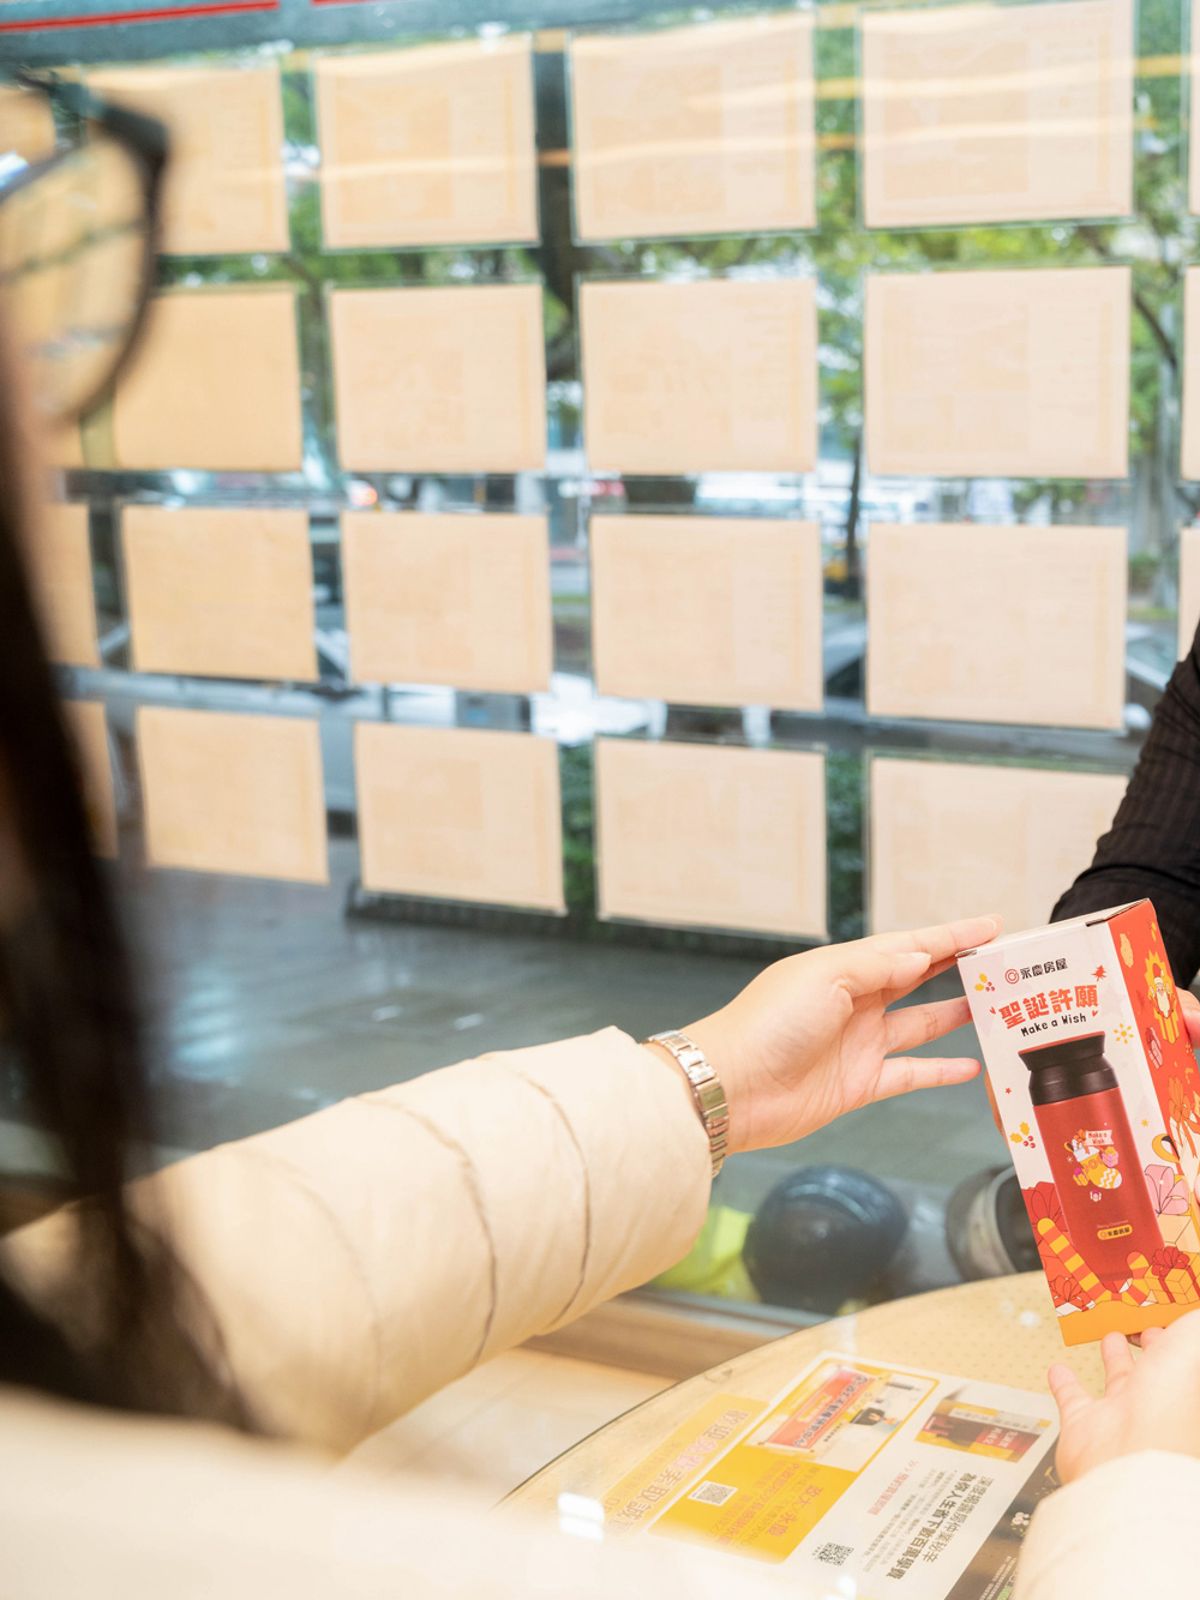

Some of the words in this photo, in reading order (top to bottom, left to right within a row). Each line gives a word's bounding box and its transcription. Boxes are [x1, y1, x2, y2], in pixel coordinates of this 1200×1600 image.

[1020, 957, 1068, 980] 永慶房屋
[999, 984, 1099, 1030] 聖誕許願
[1021, 1020, 1048, 1037] Make
[1051, 1019, 1058, 1028] a
[1061, 1012, 1087, 1025] Wish
